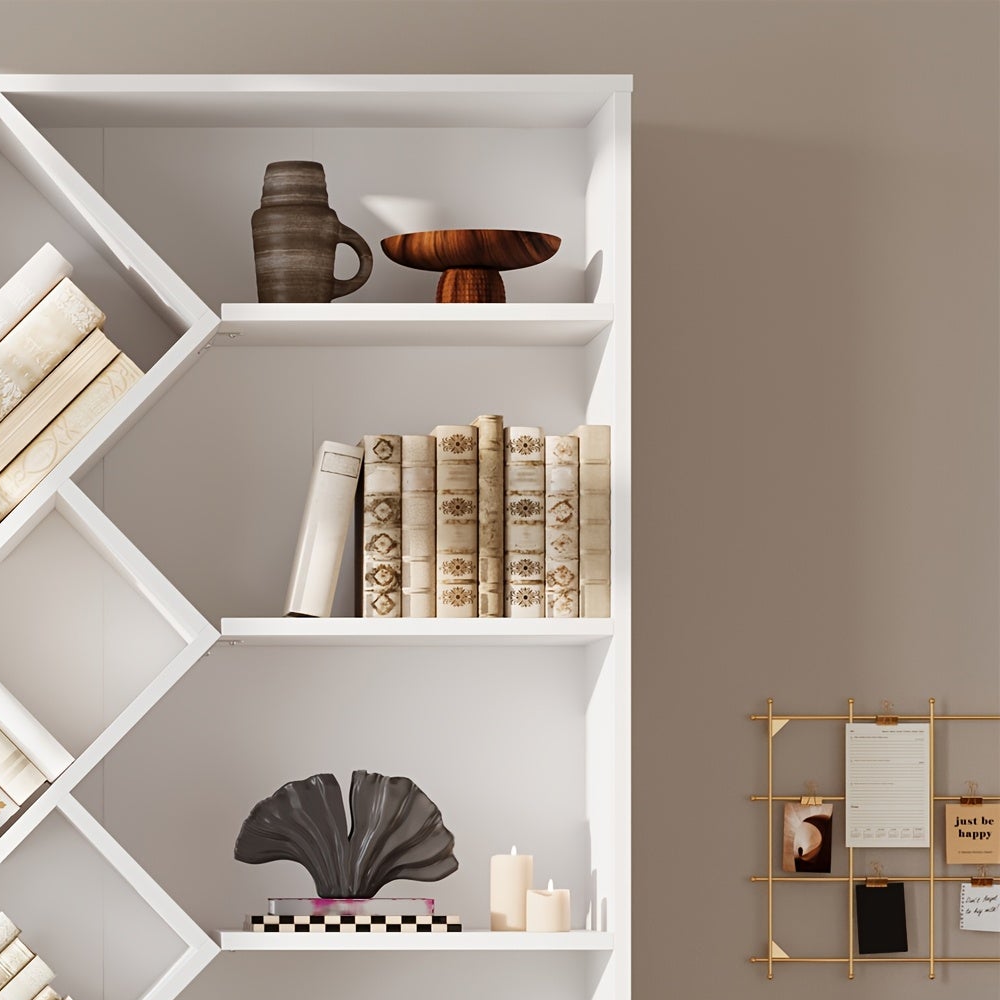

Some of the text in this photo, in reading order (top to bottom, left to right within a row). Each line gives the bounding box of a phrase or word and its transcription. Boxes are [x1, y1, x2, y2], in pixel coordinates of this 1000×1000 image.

[954, 816, 994, 828] just be
[958, 829, 992, 840] happy
